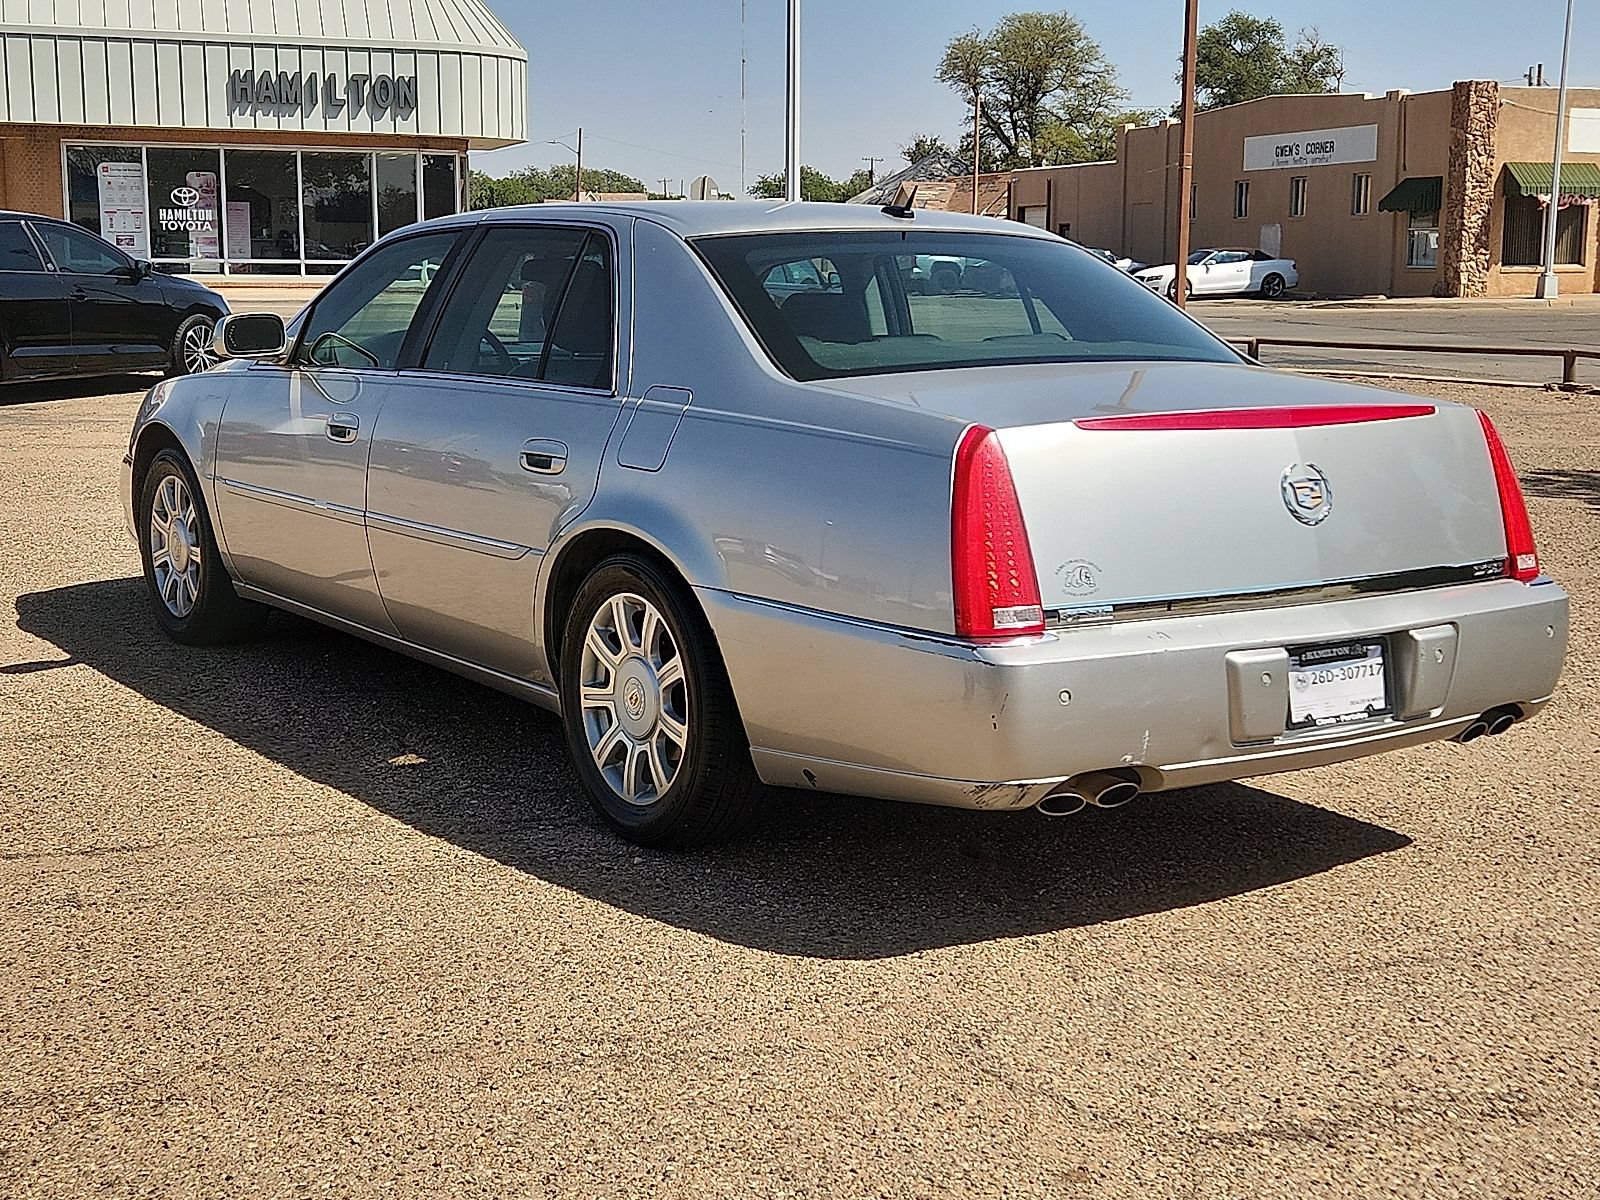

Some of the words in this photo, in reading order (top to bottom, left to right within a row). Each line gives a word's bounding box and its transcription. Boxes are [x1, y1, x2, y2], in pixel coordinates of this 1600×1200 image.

[226, 69, 416, 121] HAMILTON
[1275, 142, 1300, 158] GWEN'S
[1305, 140, 1335, 155] CORNER
[159, 208, 212, 221] HAMILTON
[160, 220, 212, 231] TOYOTA
[1311, 663, 1384, 685] 26D-307717
